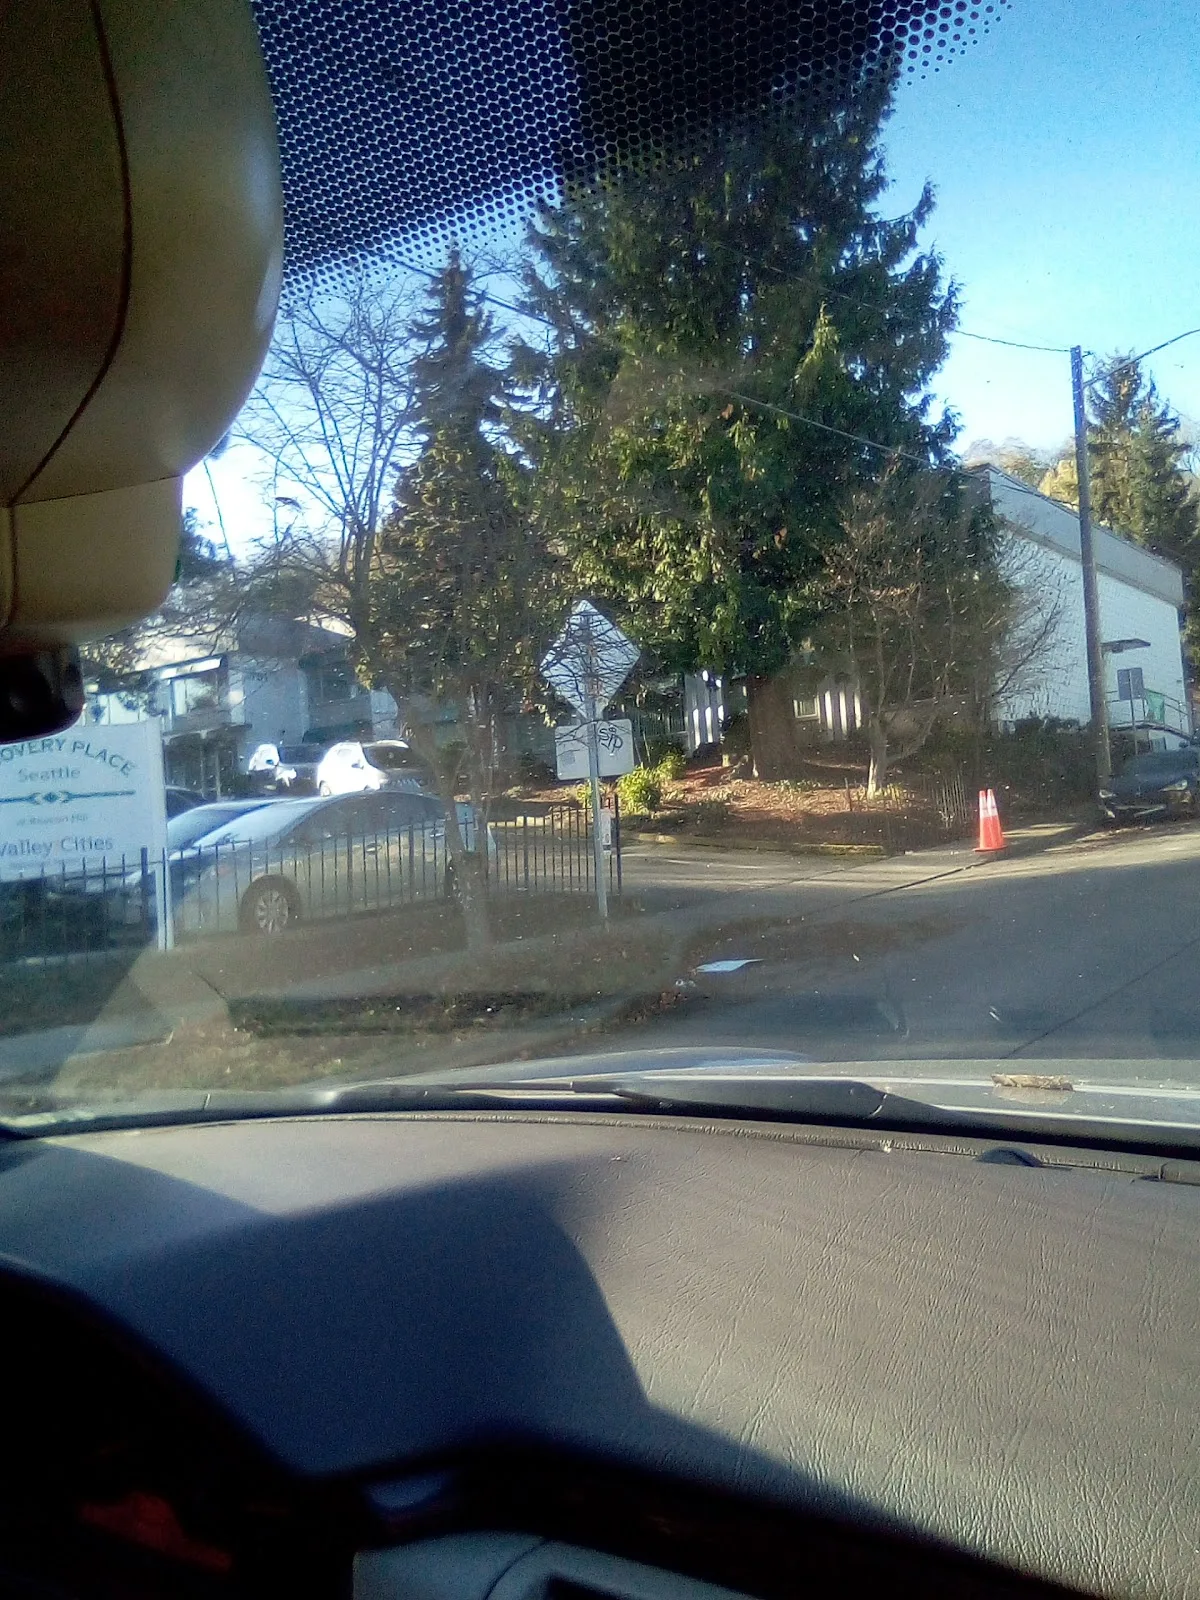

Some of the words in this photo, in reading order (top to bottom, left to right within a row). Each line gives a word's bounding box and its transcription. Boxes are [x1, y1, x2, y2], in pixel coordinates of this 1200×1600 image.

[72, 740, 136, 777] PLACE
[18, 766, 81, 782] Seattle
[61, 836, 113, 851] Cities
